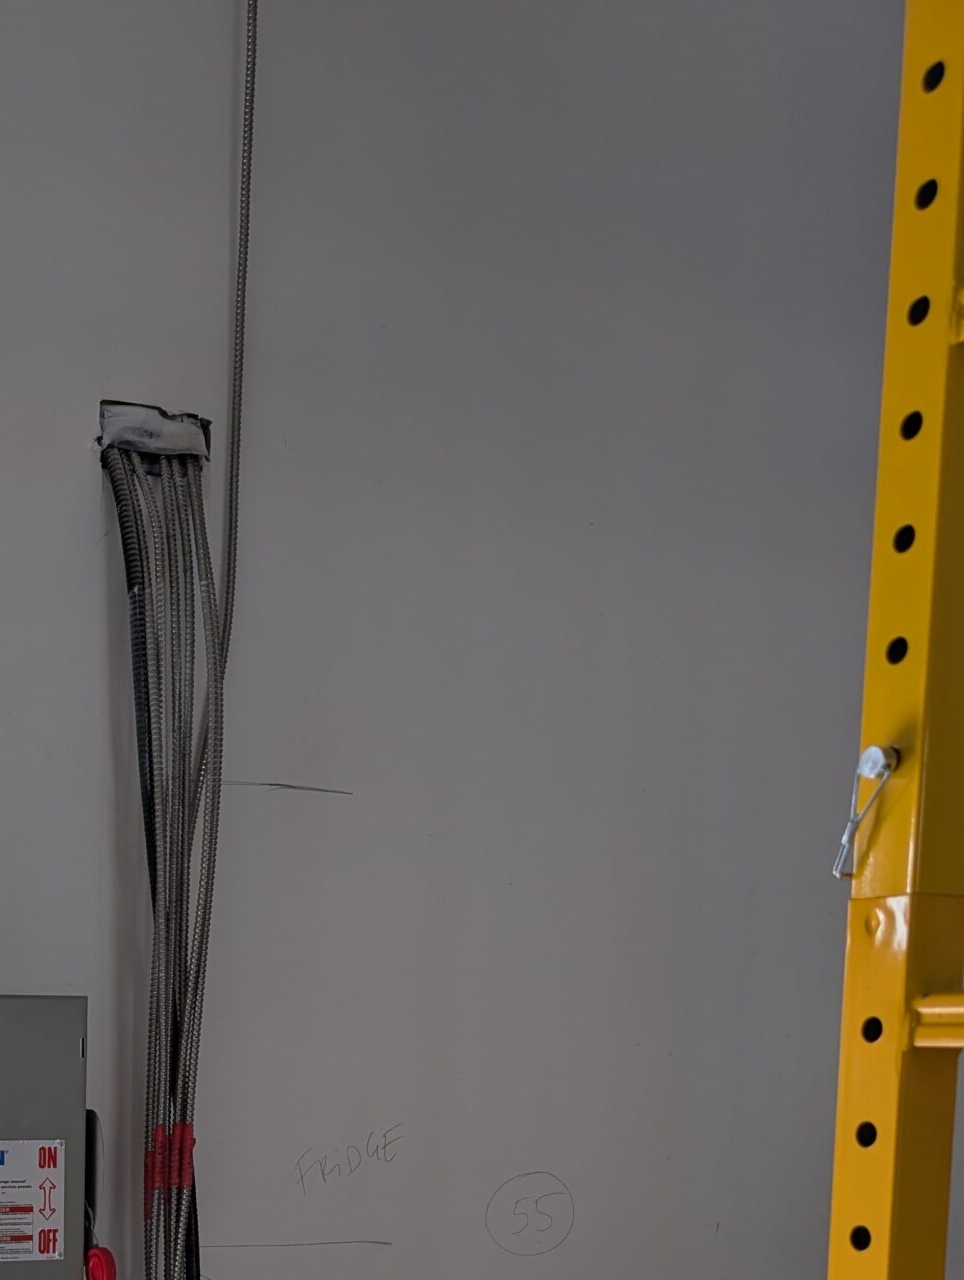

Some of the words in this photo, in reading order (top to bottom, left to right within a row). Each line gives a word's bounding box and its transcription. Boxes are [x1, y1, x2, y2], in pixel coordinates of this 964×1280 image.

[38, 1146, 58, 1169] ON
[511, 1192, 567, 1236] 55
[38, 1229, 59, 1254] OFF
